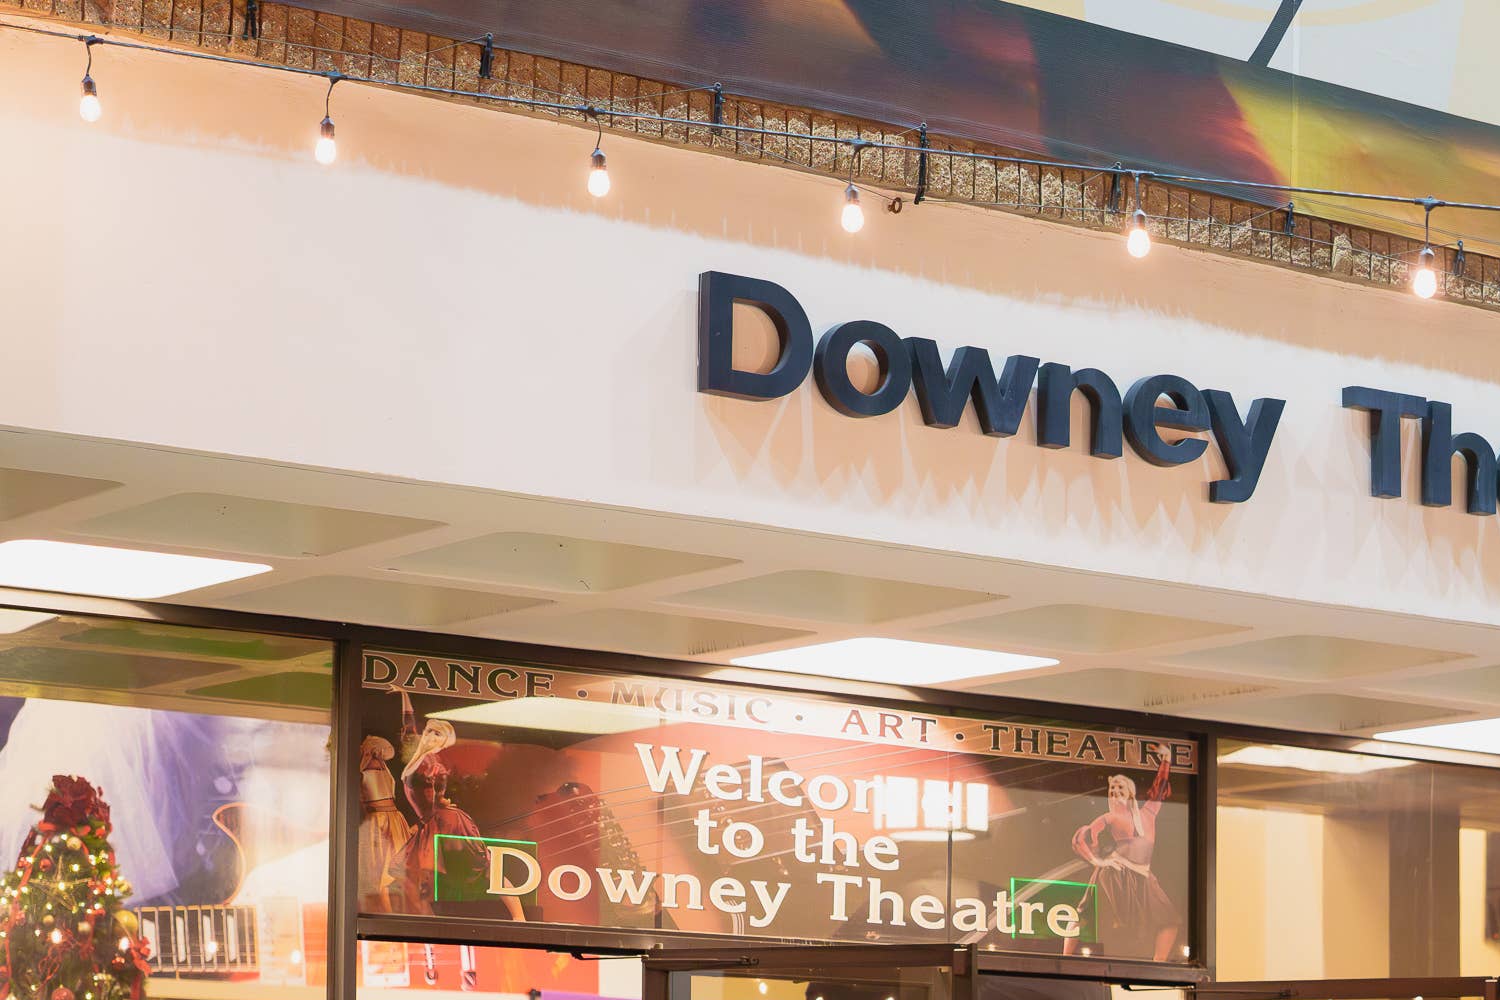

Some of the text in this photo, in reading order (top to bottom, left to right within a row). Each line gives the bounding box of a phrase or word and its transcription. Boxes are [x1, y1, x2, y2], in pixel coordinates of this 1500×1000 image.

[697, 269, 1286, 503] Downey
[362, 652, 1195, 770] DANCE MUSIC ART THEATRE
[634, 742, 950, 820] Welco
[693, 807, 900, 872] to the
[486, 844, 1082, 939] Downey Theatre
